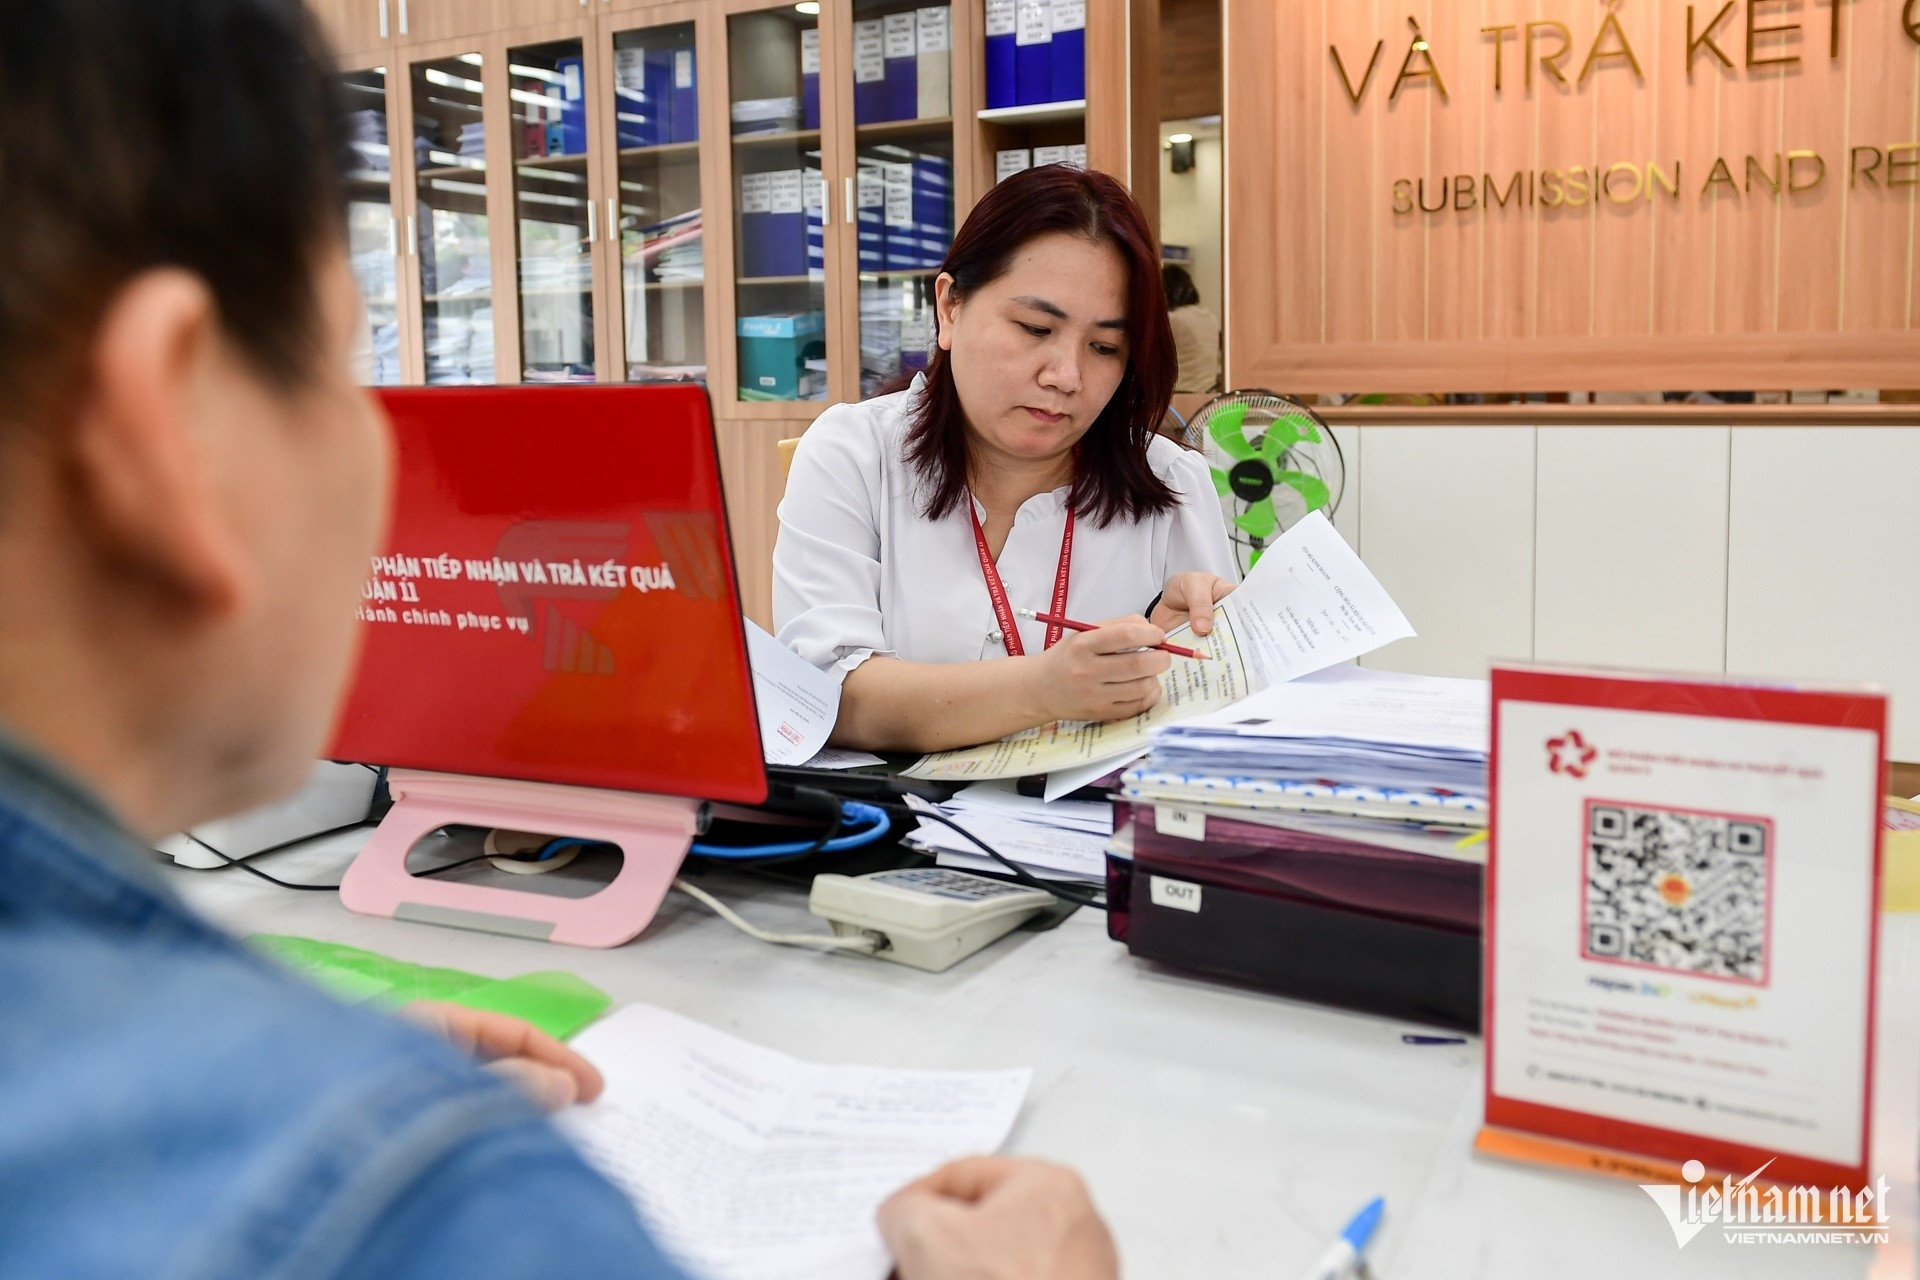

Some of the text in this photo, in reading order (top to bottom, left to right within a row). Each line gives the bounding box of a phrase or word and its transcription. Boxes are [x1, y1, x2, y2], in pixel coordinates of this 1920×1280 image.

[1329, 15, 1447, 103] VÀ
[1392, 160, 1681, 215] SUBMISSION
[1701, 149, 1827, 197] AND
[371, 552, 677, 593] PHẬN TIẾP NHẬN VÀ TRẢ KẾT QUẢ
[360, 577, 420, 604] UẬN 11
[401, 607, 452, 627] chính
[456, 611, 502, 633] phục
[505, 616, 530, 635] vụ
[1172, 810, 1188, 823] IN
[1164, 883, 1194, 900] OUT
